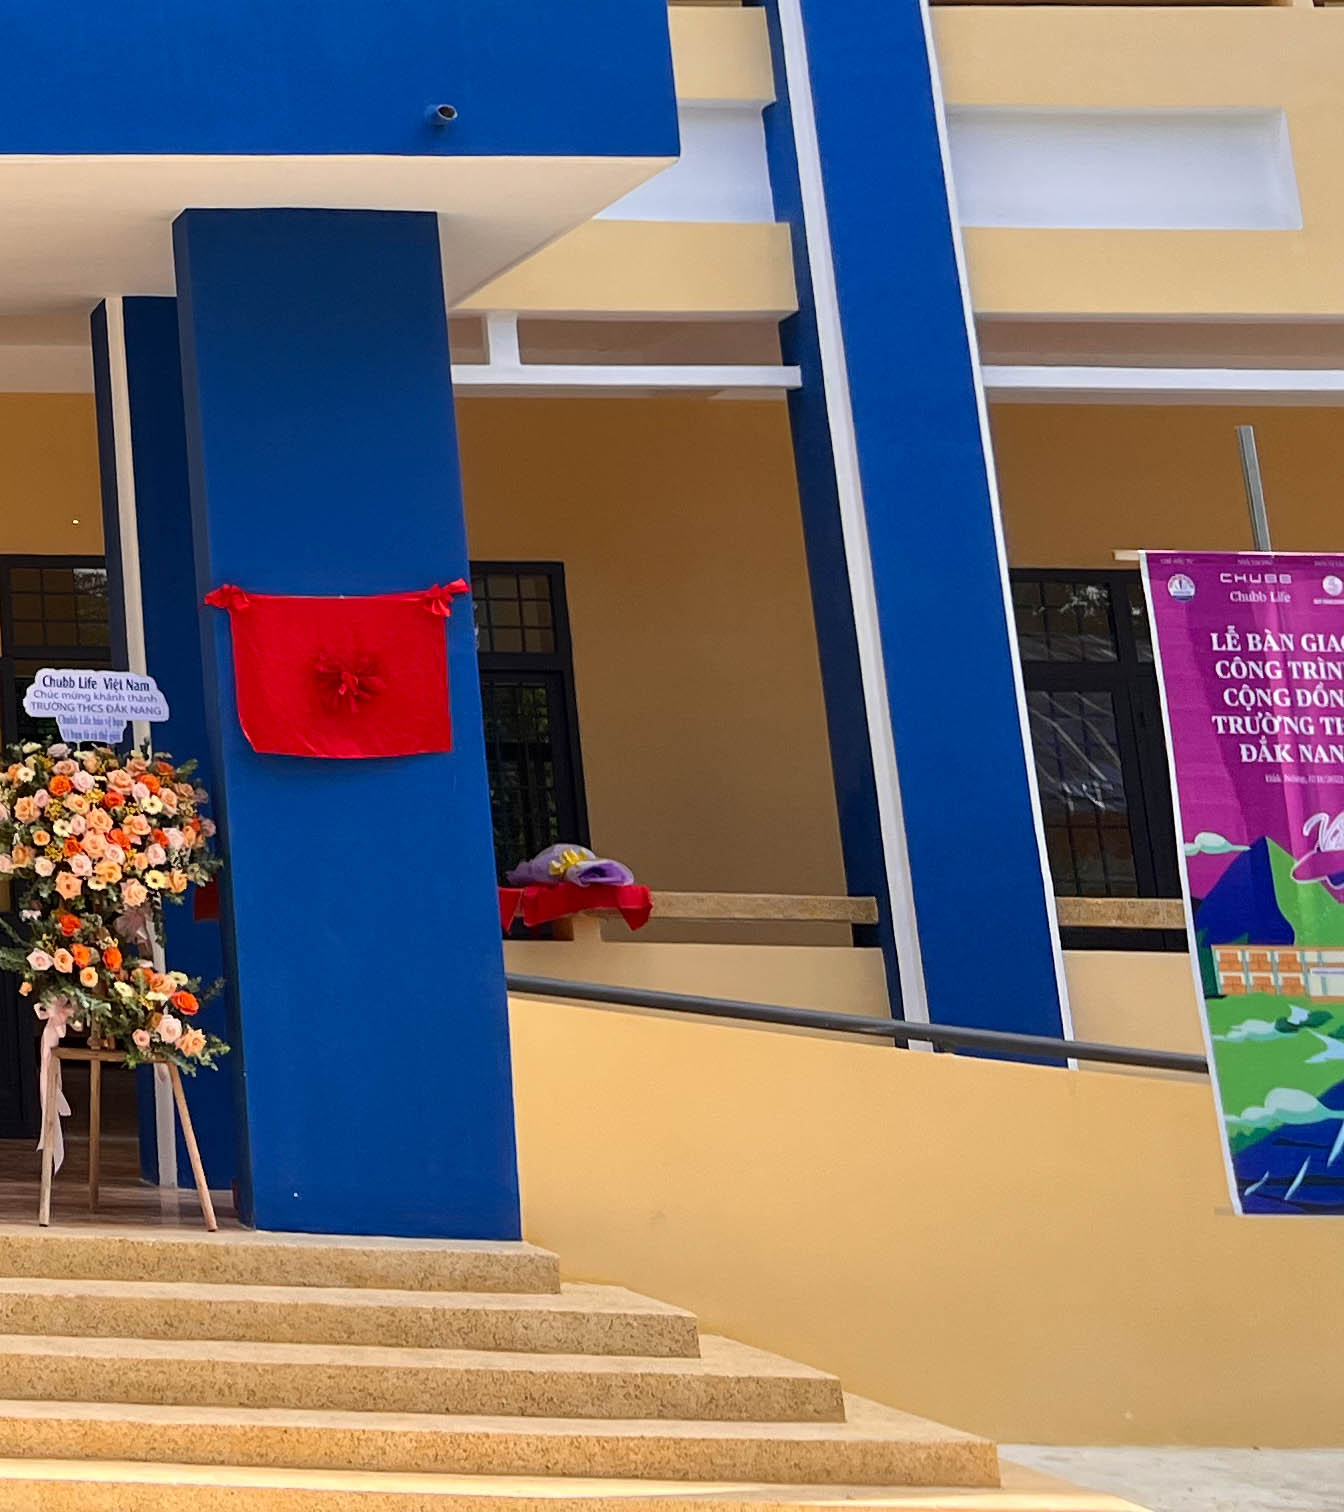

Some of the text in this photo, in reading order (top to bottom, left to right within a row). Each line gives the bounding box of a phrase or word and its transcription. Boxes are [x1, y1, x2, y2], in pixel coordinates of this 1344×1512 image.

[1219, 572, 1292, 584] CHUBB
[1229, 590, 1292, 604] Chubb Life
[1210, 624, 1344, 653] LỄ BÀN GIA
[1215, 656, 1344, 681] CÔNG TRÌN
[42, 675, 150, 693] Chubb Life Việt Nam
[1223, 683, 1292, 711] CỘNG
[1212, 711, 1315, 735] TRƯỜNG
[1239, 735, 1295, 763] ĐẮK
